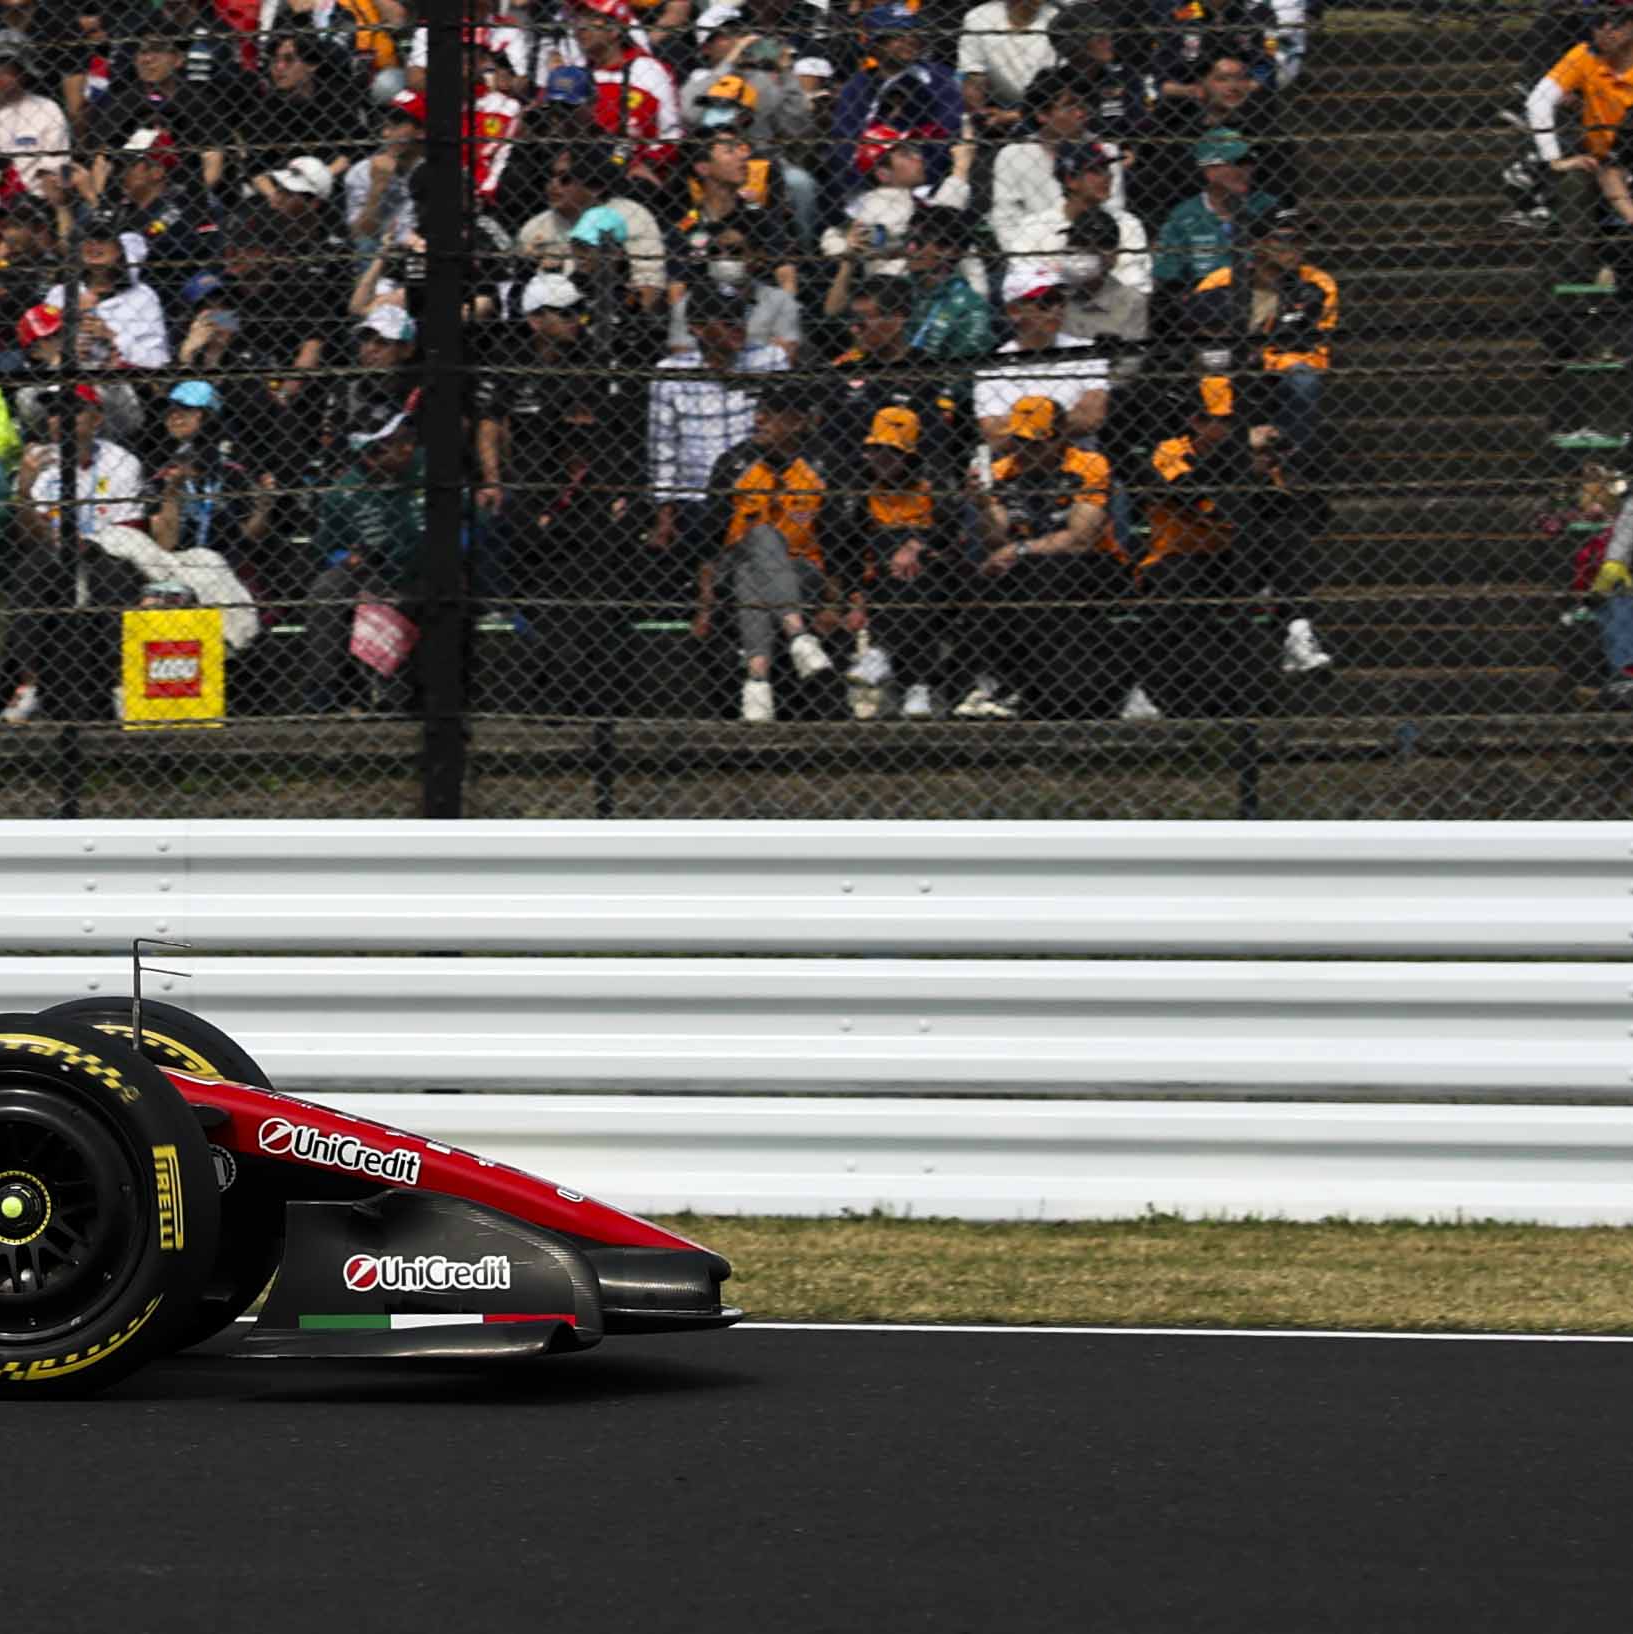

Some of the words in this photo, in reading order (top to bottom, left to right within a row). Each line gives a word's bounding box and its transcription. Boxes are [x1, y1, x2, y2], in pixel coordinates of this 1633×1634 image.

[149, 658, 197, 681] LEGO
[294, 1129, 419, 1183] UniCredit
[152, 1144, 184, 1250] PIRELLI
[380, 1257, 509, 1288] UniCredit
